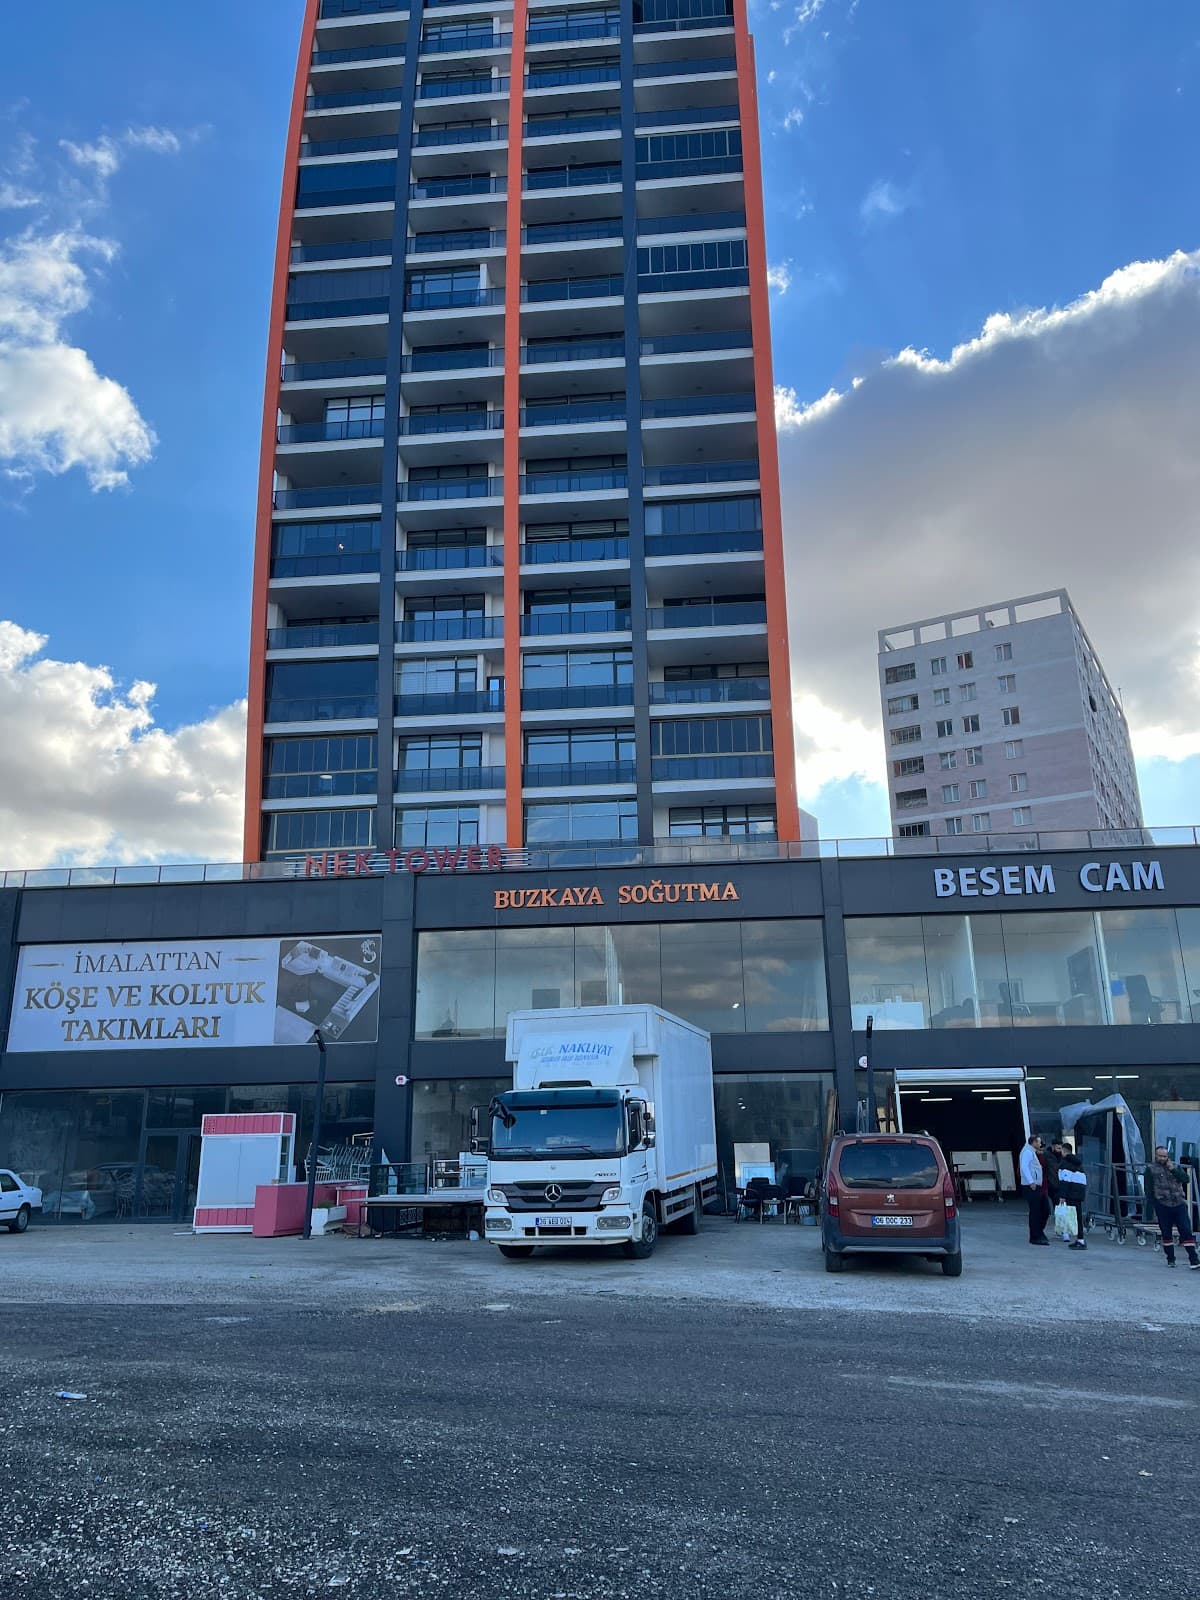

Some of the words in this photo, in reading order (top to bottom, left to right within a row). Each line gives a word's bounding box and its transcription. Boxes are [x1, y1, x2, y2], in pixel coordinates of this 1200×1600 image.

[305, 851, 373, 877] NEK
[385, 845, 505, 873] TOWER
[493, 886, 605, 909] BUZKAYA
[618, 879, 740, 904] SOĞUTMA
[934, 865, 1056, 897] BESEM
[1080, 861, 1165, 892] CAM
[72, 950, 223, 974] İMALATTAN
[23, 981, 99, 1014] KÖŞE
[106, 985, 142, 1008] VE
[148, 981, 266, 1006] KOLTUK
[61, 1015, 222, 1042] TAKIMLARI
